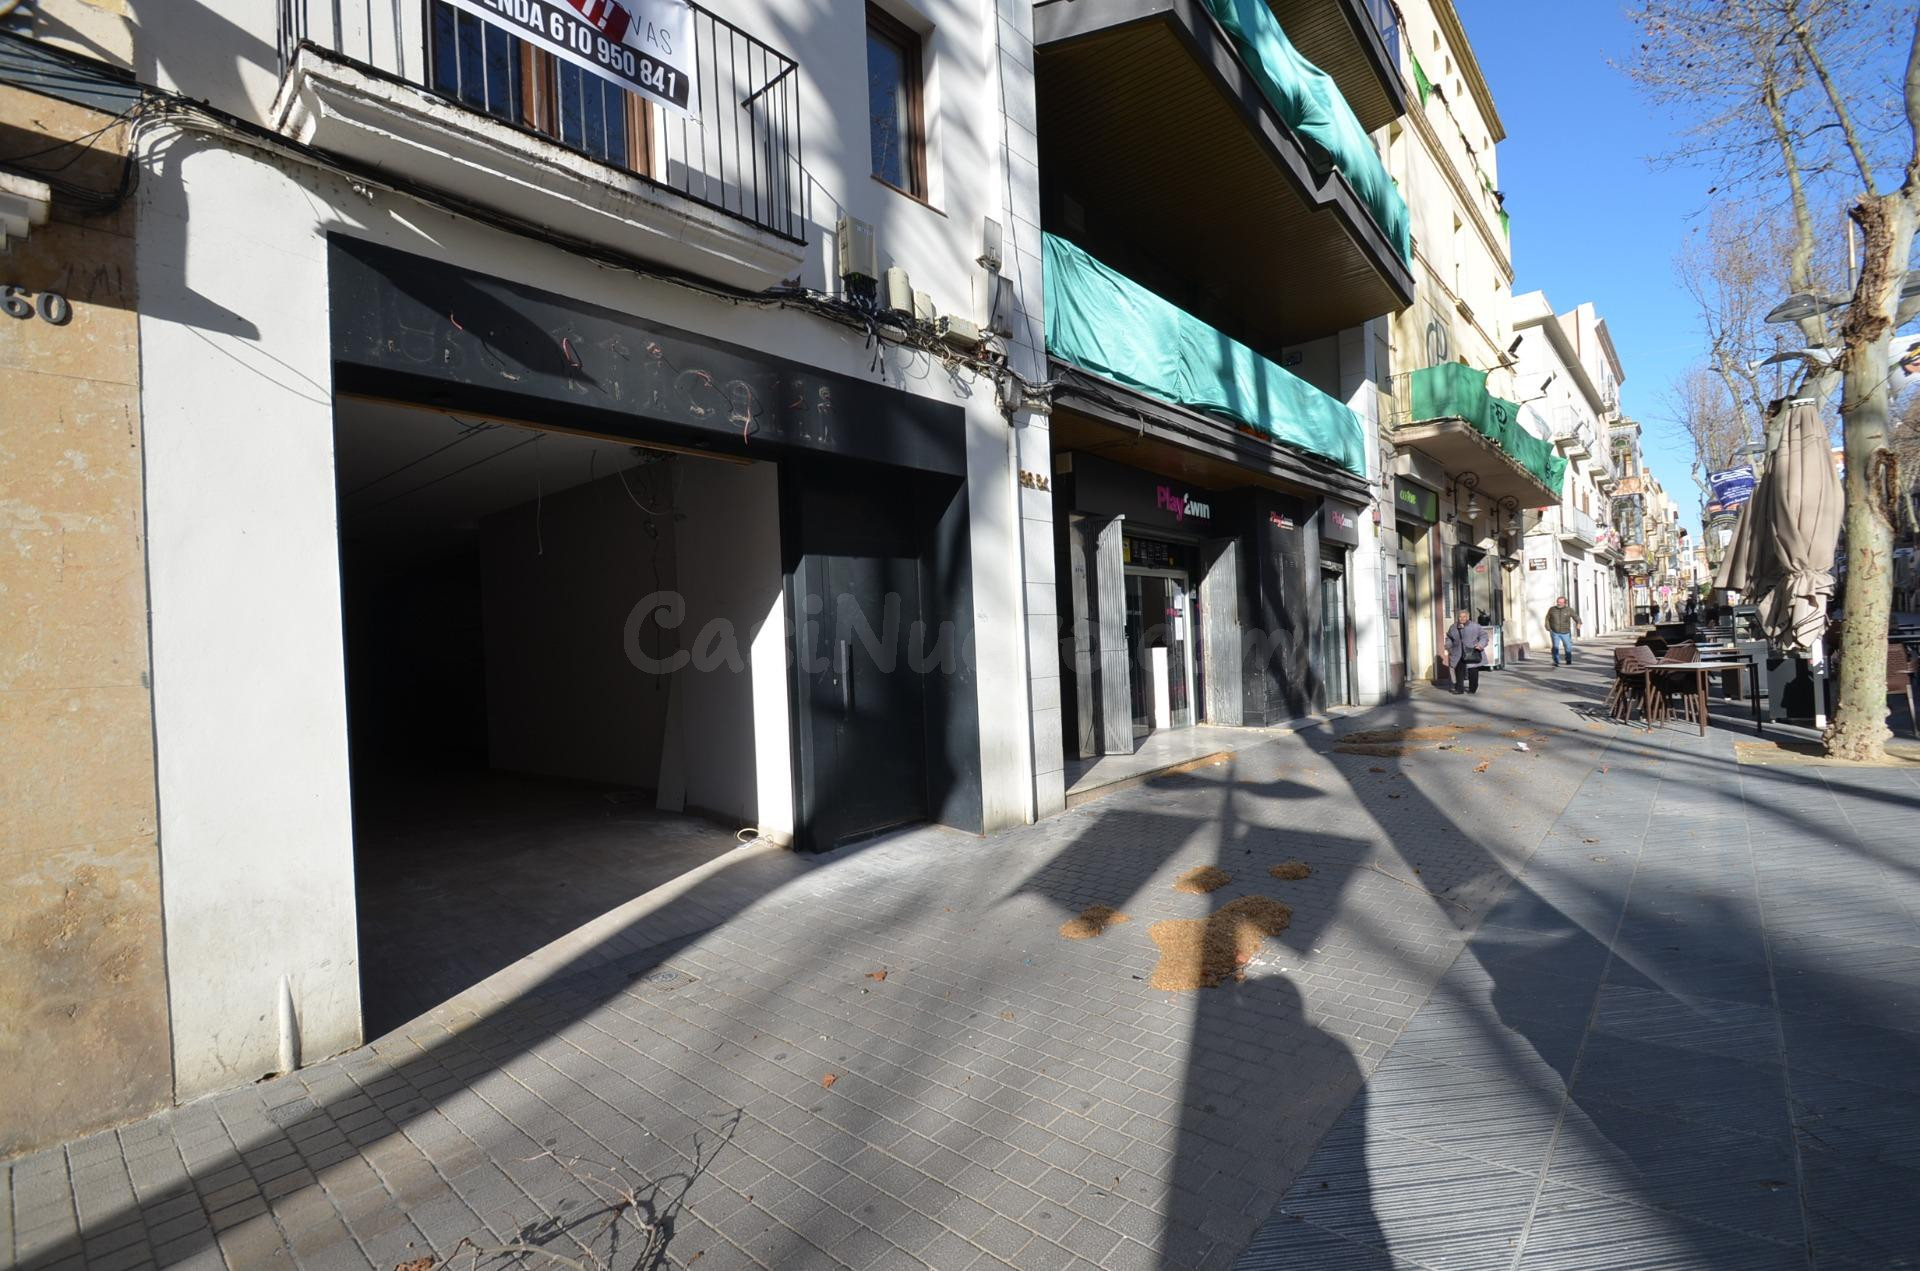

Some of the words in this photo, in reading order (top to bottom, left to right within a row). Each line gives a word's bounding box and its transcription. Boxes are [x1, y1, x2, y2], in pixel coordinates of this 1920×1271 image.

[483, 0, 545, 33] NDA
[549, 12, 592, 55] 610
[597, 36, 636, 77] 950
[640, 61, 676, 98] 841
[0, 284, 67, 324] 60
